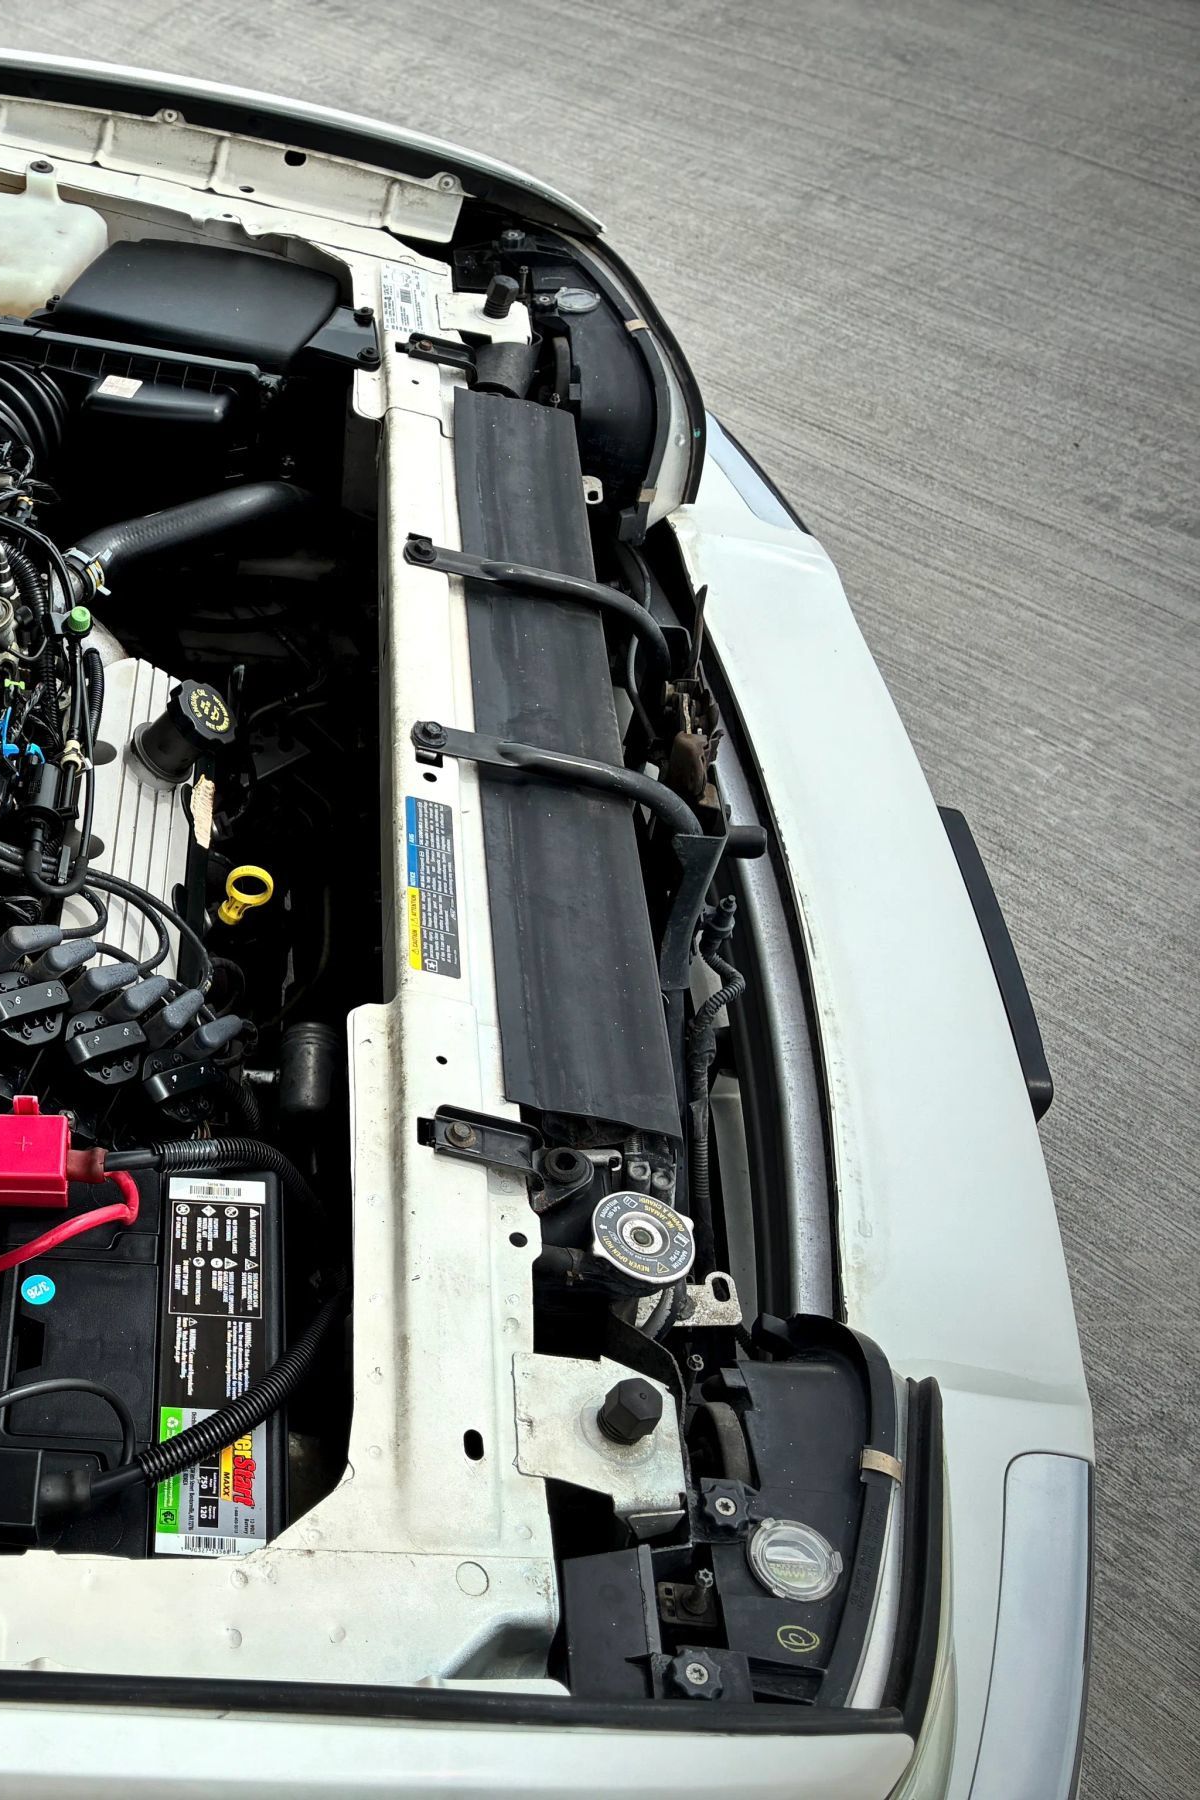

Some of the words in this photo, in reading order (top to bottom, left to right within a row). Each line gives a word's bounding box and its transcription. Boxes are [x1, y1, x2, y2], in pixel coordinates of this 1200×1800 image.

[191, 691, 203, 718] ENGINE
[197, 689, 208, 697] OIL
[15, 996, 22, 1005] 6
[94, 1035, 101, 1045] 2
[645, 1205, 668, 1222] JAMAIS
[665, 1220, 675, 1229] NE
[667, 1210, 685, 1232] OUVRIR
[602, 1236, 615, 1251] HOT!
[613, 1249, 628, 1263] OPEN
[672, 1250, 688, 1269] RADIATOR
[629, 1261, 650, 1273] NEVER
